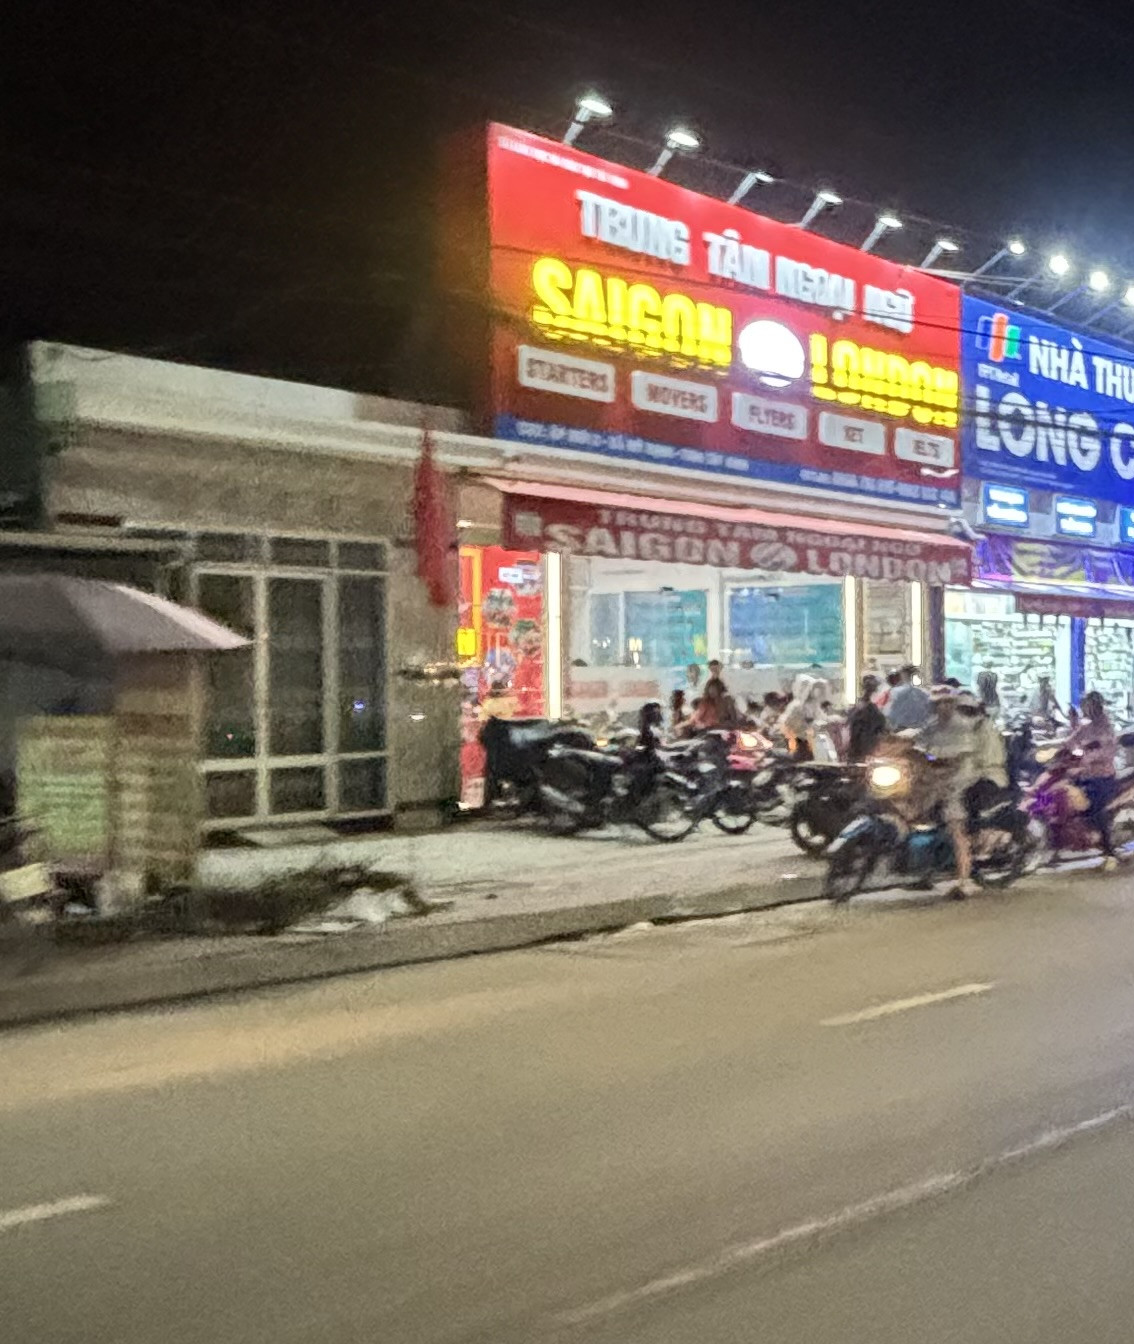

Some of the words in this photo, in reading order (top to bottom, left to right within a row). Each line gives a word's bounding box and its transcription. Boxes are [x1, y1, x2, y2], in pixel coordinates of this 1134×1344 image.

[532, 257, 733, 367] SAIGON
[526, 357, 610, 394] STARTERS
[1028, 335, 1089, 390] NHÀ
[646, 382, 709, 414] MOVERS
[749, 404, 796, 431] FLYERS
[975, 383, 1101, 472] LONG
[543, 522, 741, 567] SAIGON
[806, 548, 952, 583] LONDON
